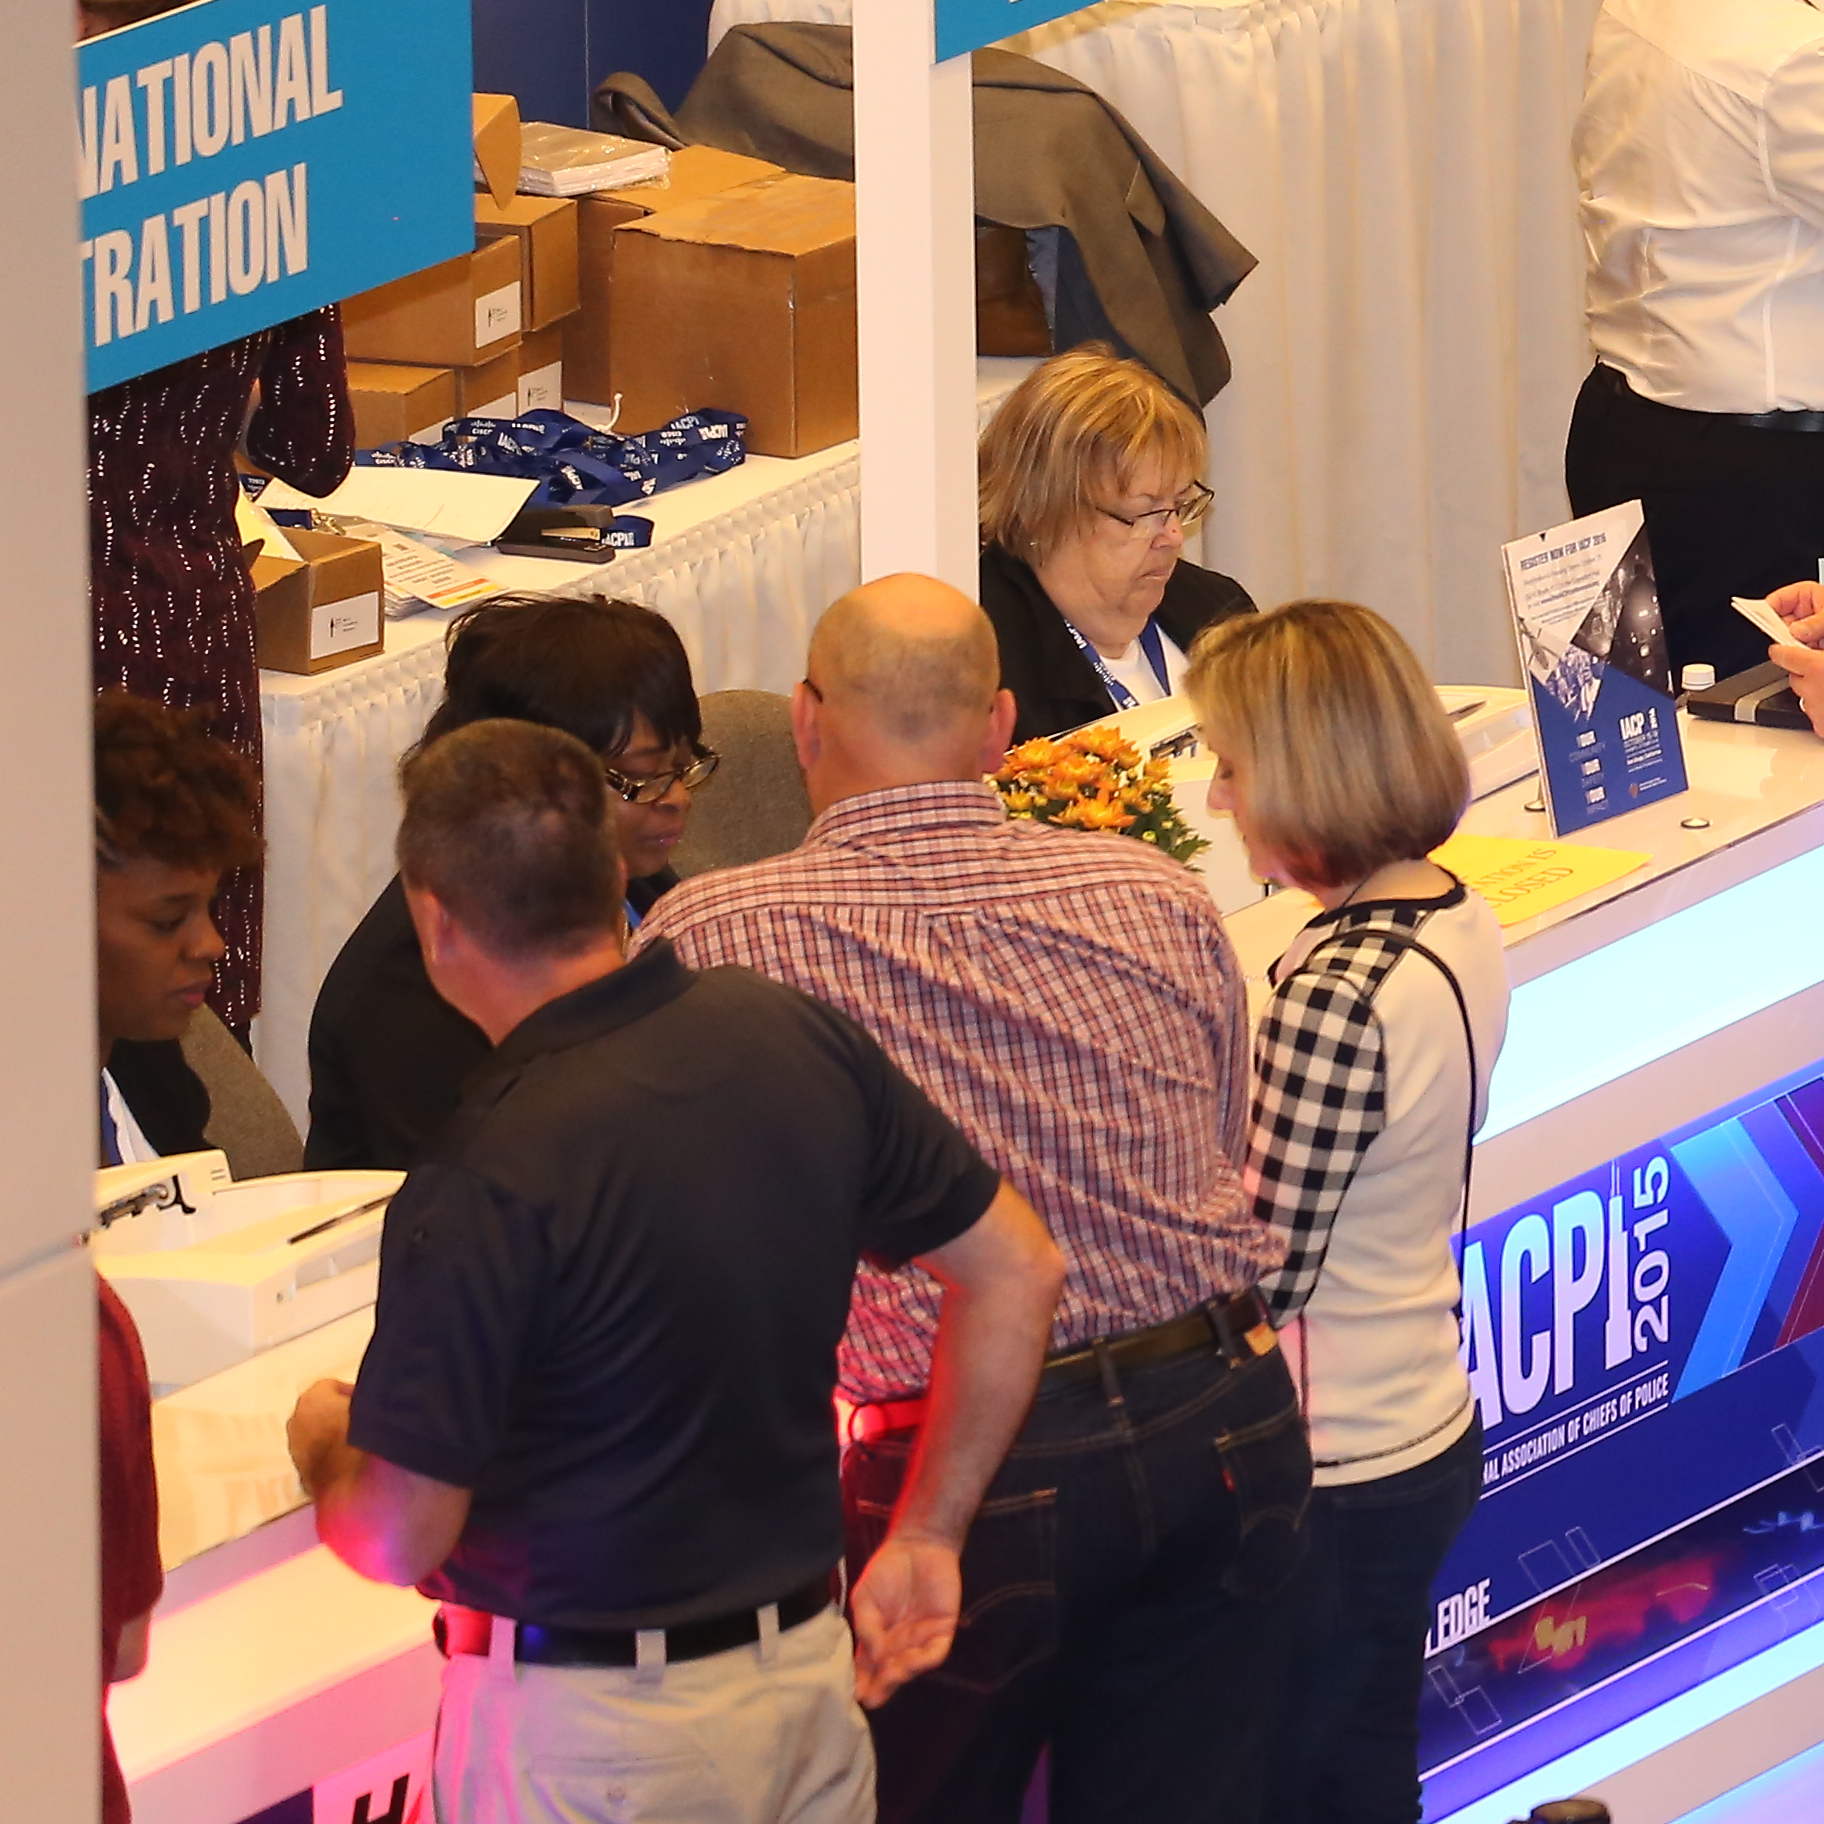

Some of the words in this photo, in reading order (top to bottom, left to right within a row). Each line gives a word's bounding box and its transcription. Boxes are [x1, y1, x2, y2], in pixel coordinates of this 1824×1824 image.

[76, 4, 343, 201] NATIONAL
[1619, 712, 1645, 740] IACP
[1459, 1189, 1604, 1431] ACP
[1633, 1155, 1670, 1353] 2015
[1501, 1426, 1566, 1478] ASSOCIATION
[1568, 1416, 1581, 1443] OF
[1583, 1400, 1618, 1437] CHIEFS
[1620, 1393, 1633, 1418] OF
[1635, 1373, 1669, 1410] POLICE
[1438, 1578, 1491, 1650] EDGE
